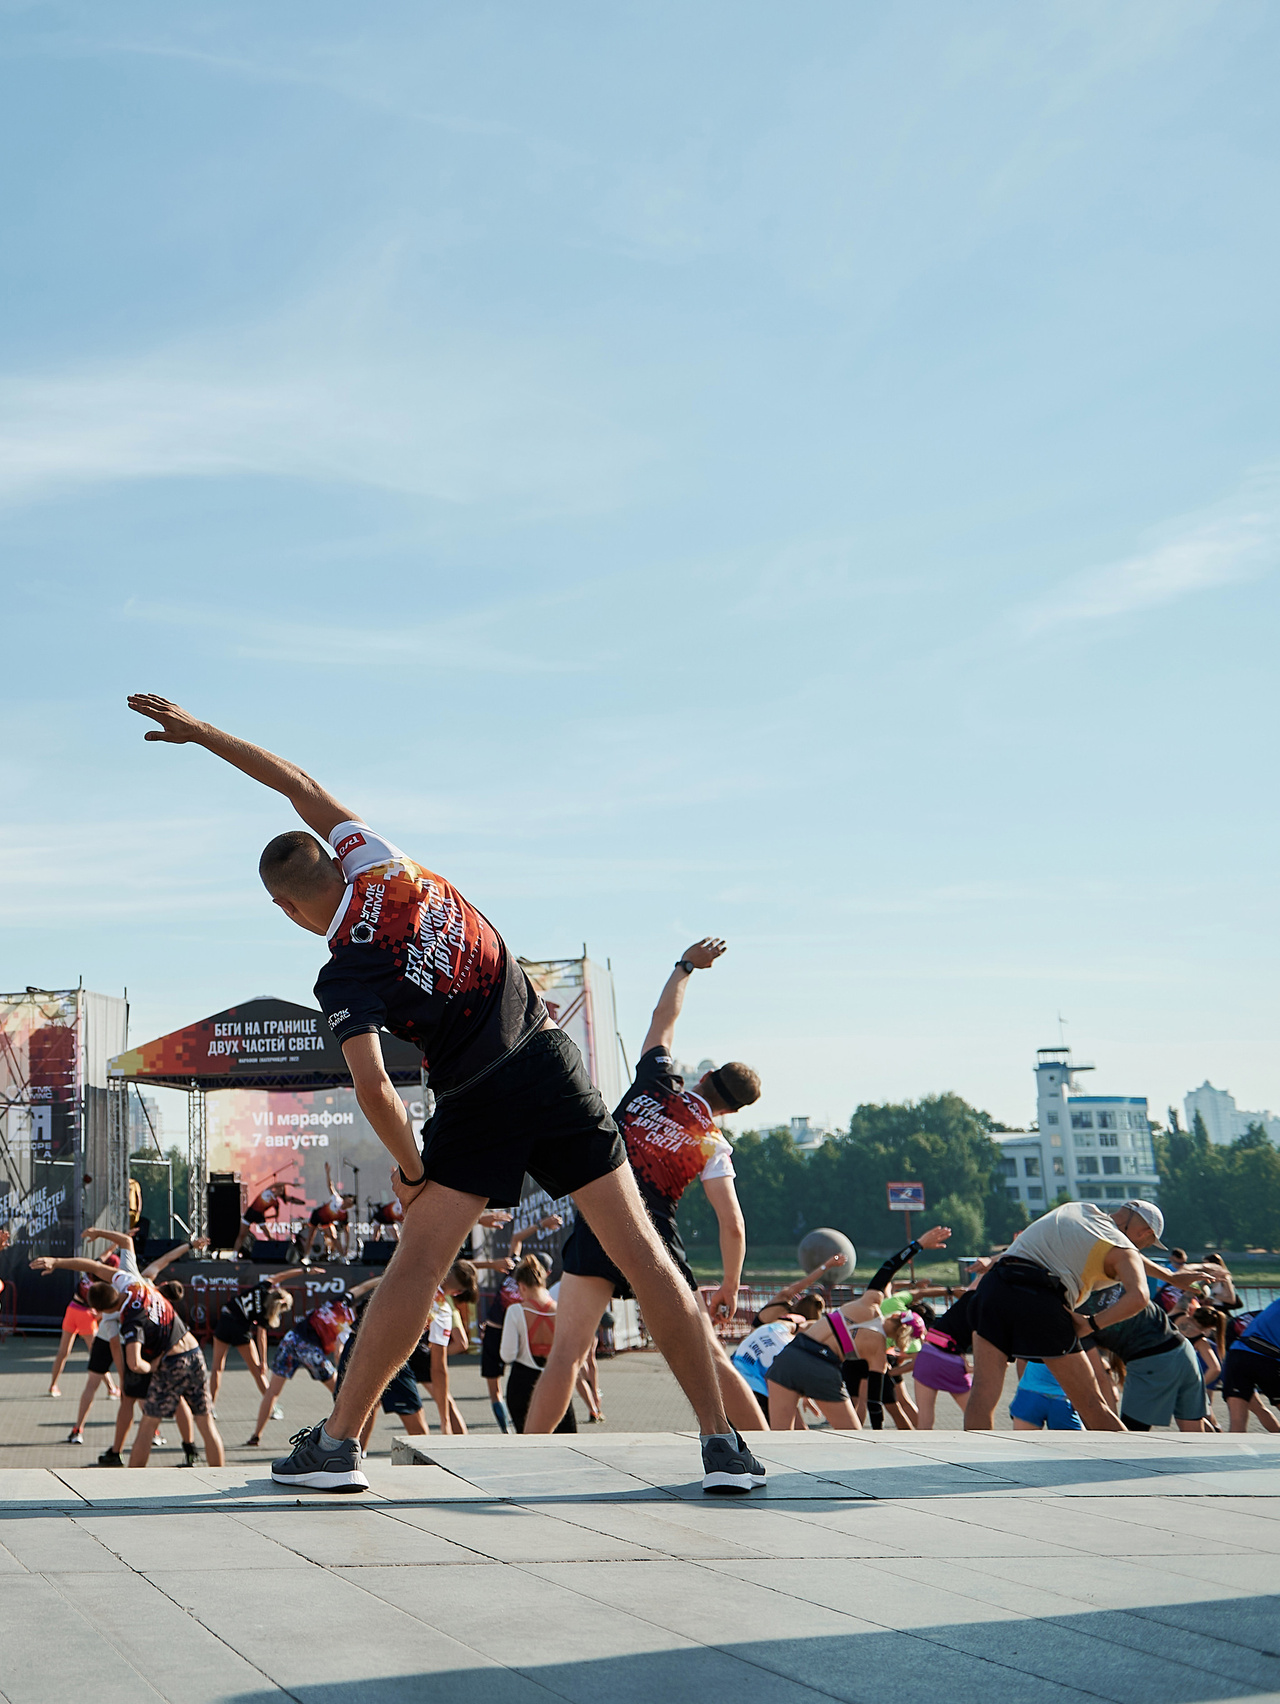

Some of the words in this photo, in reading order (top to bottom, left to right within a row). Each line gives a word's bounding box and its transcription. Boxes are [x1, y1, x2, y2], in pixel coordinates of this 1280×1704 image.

[360, 883, 376, 920] УГМК
[369, 884, 386, 924] UMMC
[405, 943, 423, 986] БЕГИ
[421, 968, 434, 995] НА
[214, 1022, 242, 1037] БЕГИ
[244, 1021, 261, 1036] НА
[264, 1019, 317, 1035] ГРАНИЦЕ
[207, 1040, 239, 1057] ДВУХ
[242, 1036, 285, 1053] ЧАСТЕЙ
[288, 1037, 325, 1051] СВЕТА
[626, 1102, 641, 1115] НА
[632, 1094, 665, 1113] БЕГИ
[277, 1111, 354, 1128] марафон
[630, 1116, 663, 1133] ДВУХ
[8, 1142, 52, 1150] EUROPE
[252, 1133, 262, 1147] 7
[265, 1134, 329, 1149] августа
[645, 1131, 683, 1153] СВЕТА
[28, 1207, 59, 1237] СВЕТА
[209, 1277, 239, 1285] УГМК
